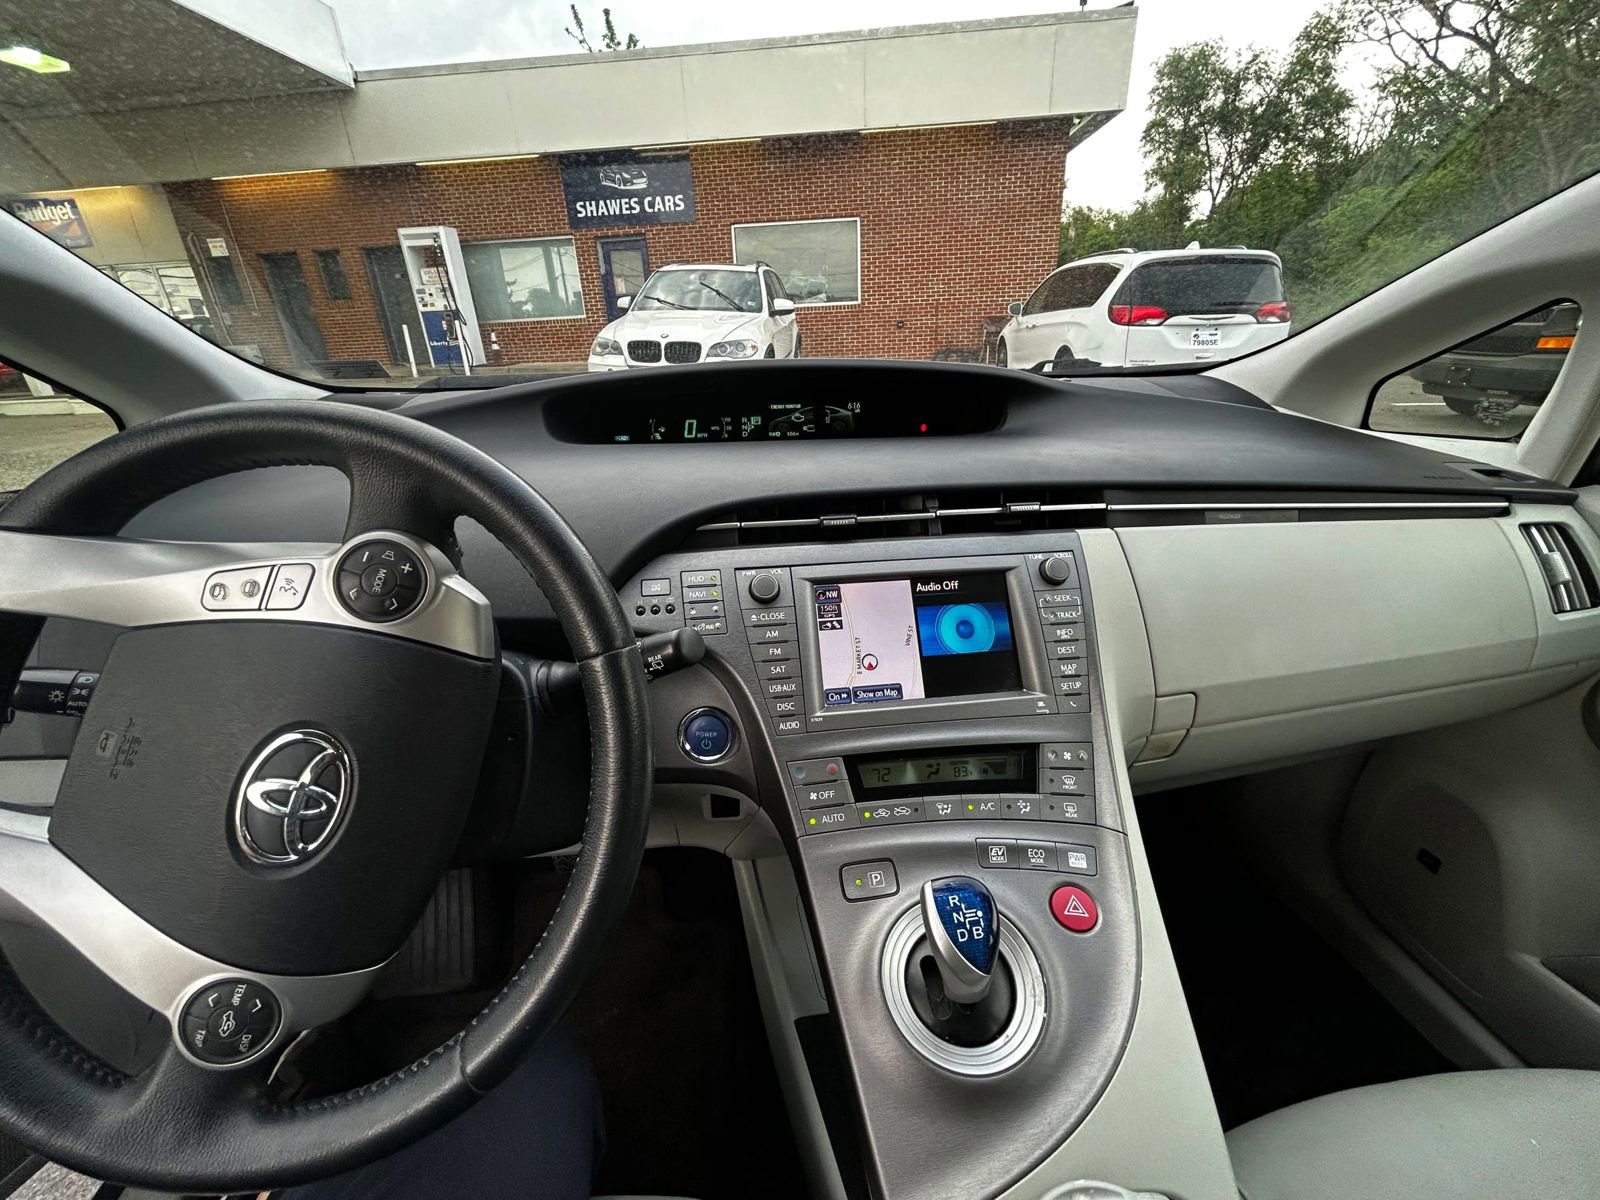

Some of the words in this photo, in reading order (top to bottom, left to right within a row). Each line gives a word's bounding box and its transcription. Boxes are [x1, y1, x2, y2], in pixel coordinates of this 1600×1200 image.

[576, 198, 640, 218] SHAWES
[644, 194, 685, 213] CARS
[12, 201, 76, 225] Budget
[684, 419, 697, 438] 0
[372, 568, 387, 593] MODE
[916, 583, 941, 592] Audio
[942, 580, 959, 590] Off
[826, 590, 838, 598] NW
[1053, 594, 1071, 602] SEEK
[760, 611, 785, 620] CLOSE
[1056, 611, 1077, 619] TRACK
[908, 624, 914, 633] ST
[1056, 628, 1073, 636] INFO
[765, 630, 779, 638] AM
[855, 636, 861, 644] ST
[904, 632, 913, 647] VINE
[1057, 645, 1076, 654] DEST
[647, 654, 662, 662] REAR
[770, 665, 786, 673] SAT
[1060, 664, 1077, 673] MAP
[1060, 681, 1082, 690] SETUP
[828, 693, 841, 701] On
[856, 690, 873, 699] Show
[884, 688, 898, 698] Map
[777, 703, 795, 711] DISC
[779, 721, 800, 730] AUDIO
[872, 767, 891, 783] 72
[953, 766, 968, 778] 83
[818, 790, 836, 800] OFF
[980, 802, 995, 812] A/C
[821, 813, 845, 824] AUTO
[991, 847, 1004, 856] EV
[1027, 848, 1045, 858] ECO
[1068, 853, 1086, 862] PWR
[871, 874, 881, 886] P
[948, 895, 960, 907] R
[952, 911, 964, 924] N
[958, 929, 969, 942] D
[973, 925, 984, 939] B
[231, 984, 246, 1006] TEMP
[195, 1029, 206, 1048] TRIP
[239, 1034, 252, 1052] DISP
